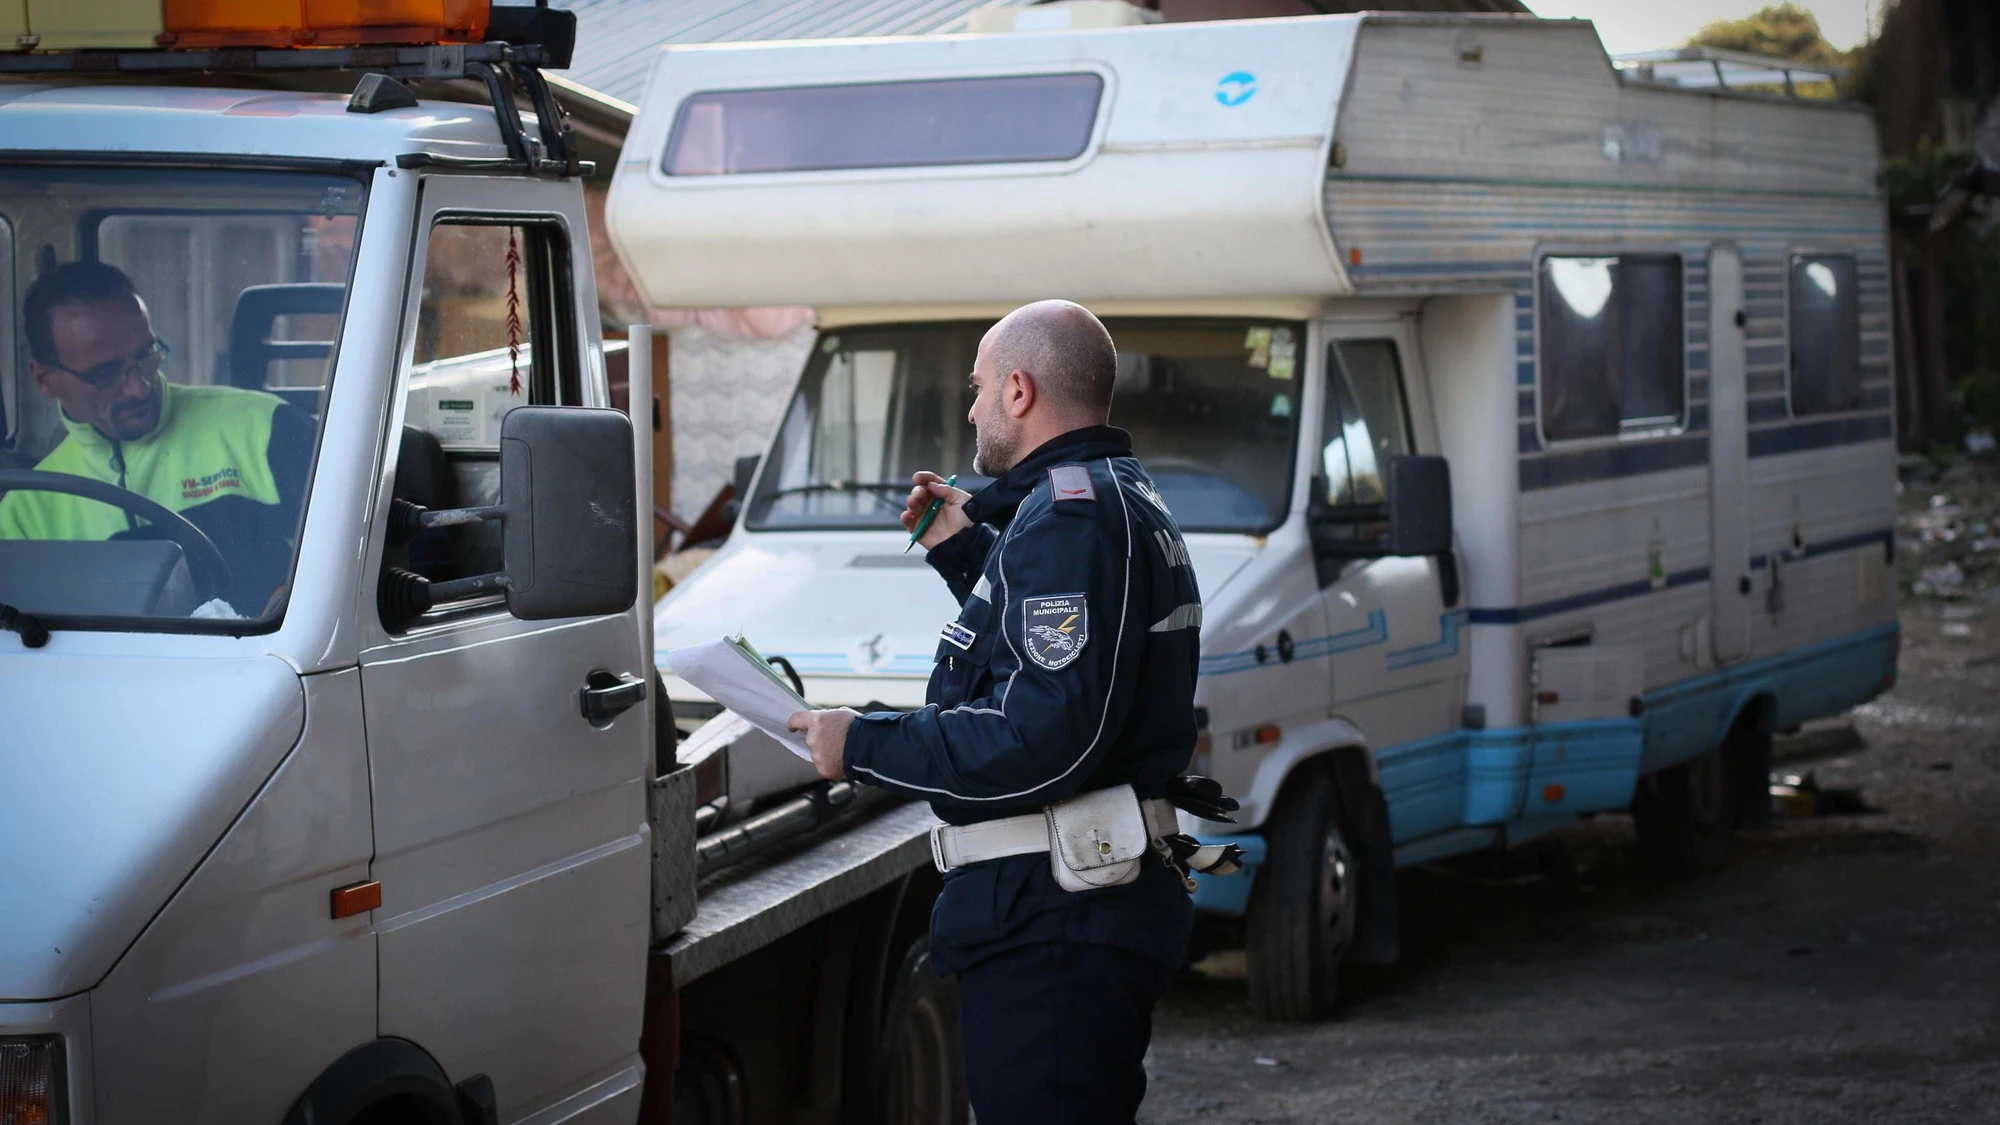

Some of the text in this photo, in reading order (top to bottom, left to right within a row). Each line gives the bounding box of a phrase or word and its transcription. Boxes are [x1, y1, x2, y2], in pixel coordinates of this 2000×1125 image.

[1040, 600, 1070, 608] POLIZIA
[1033, 607, 1078, 616] MUNICIPALE
[1027, 634, 1085, 666] SEZIONE MOTOCICLISTI
